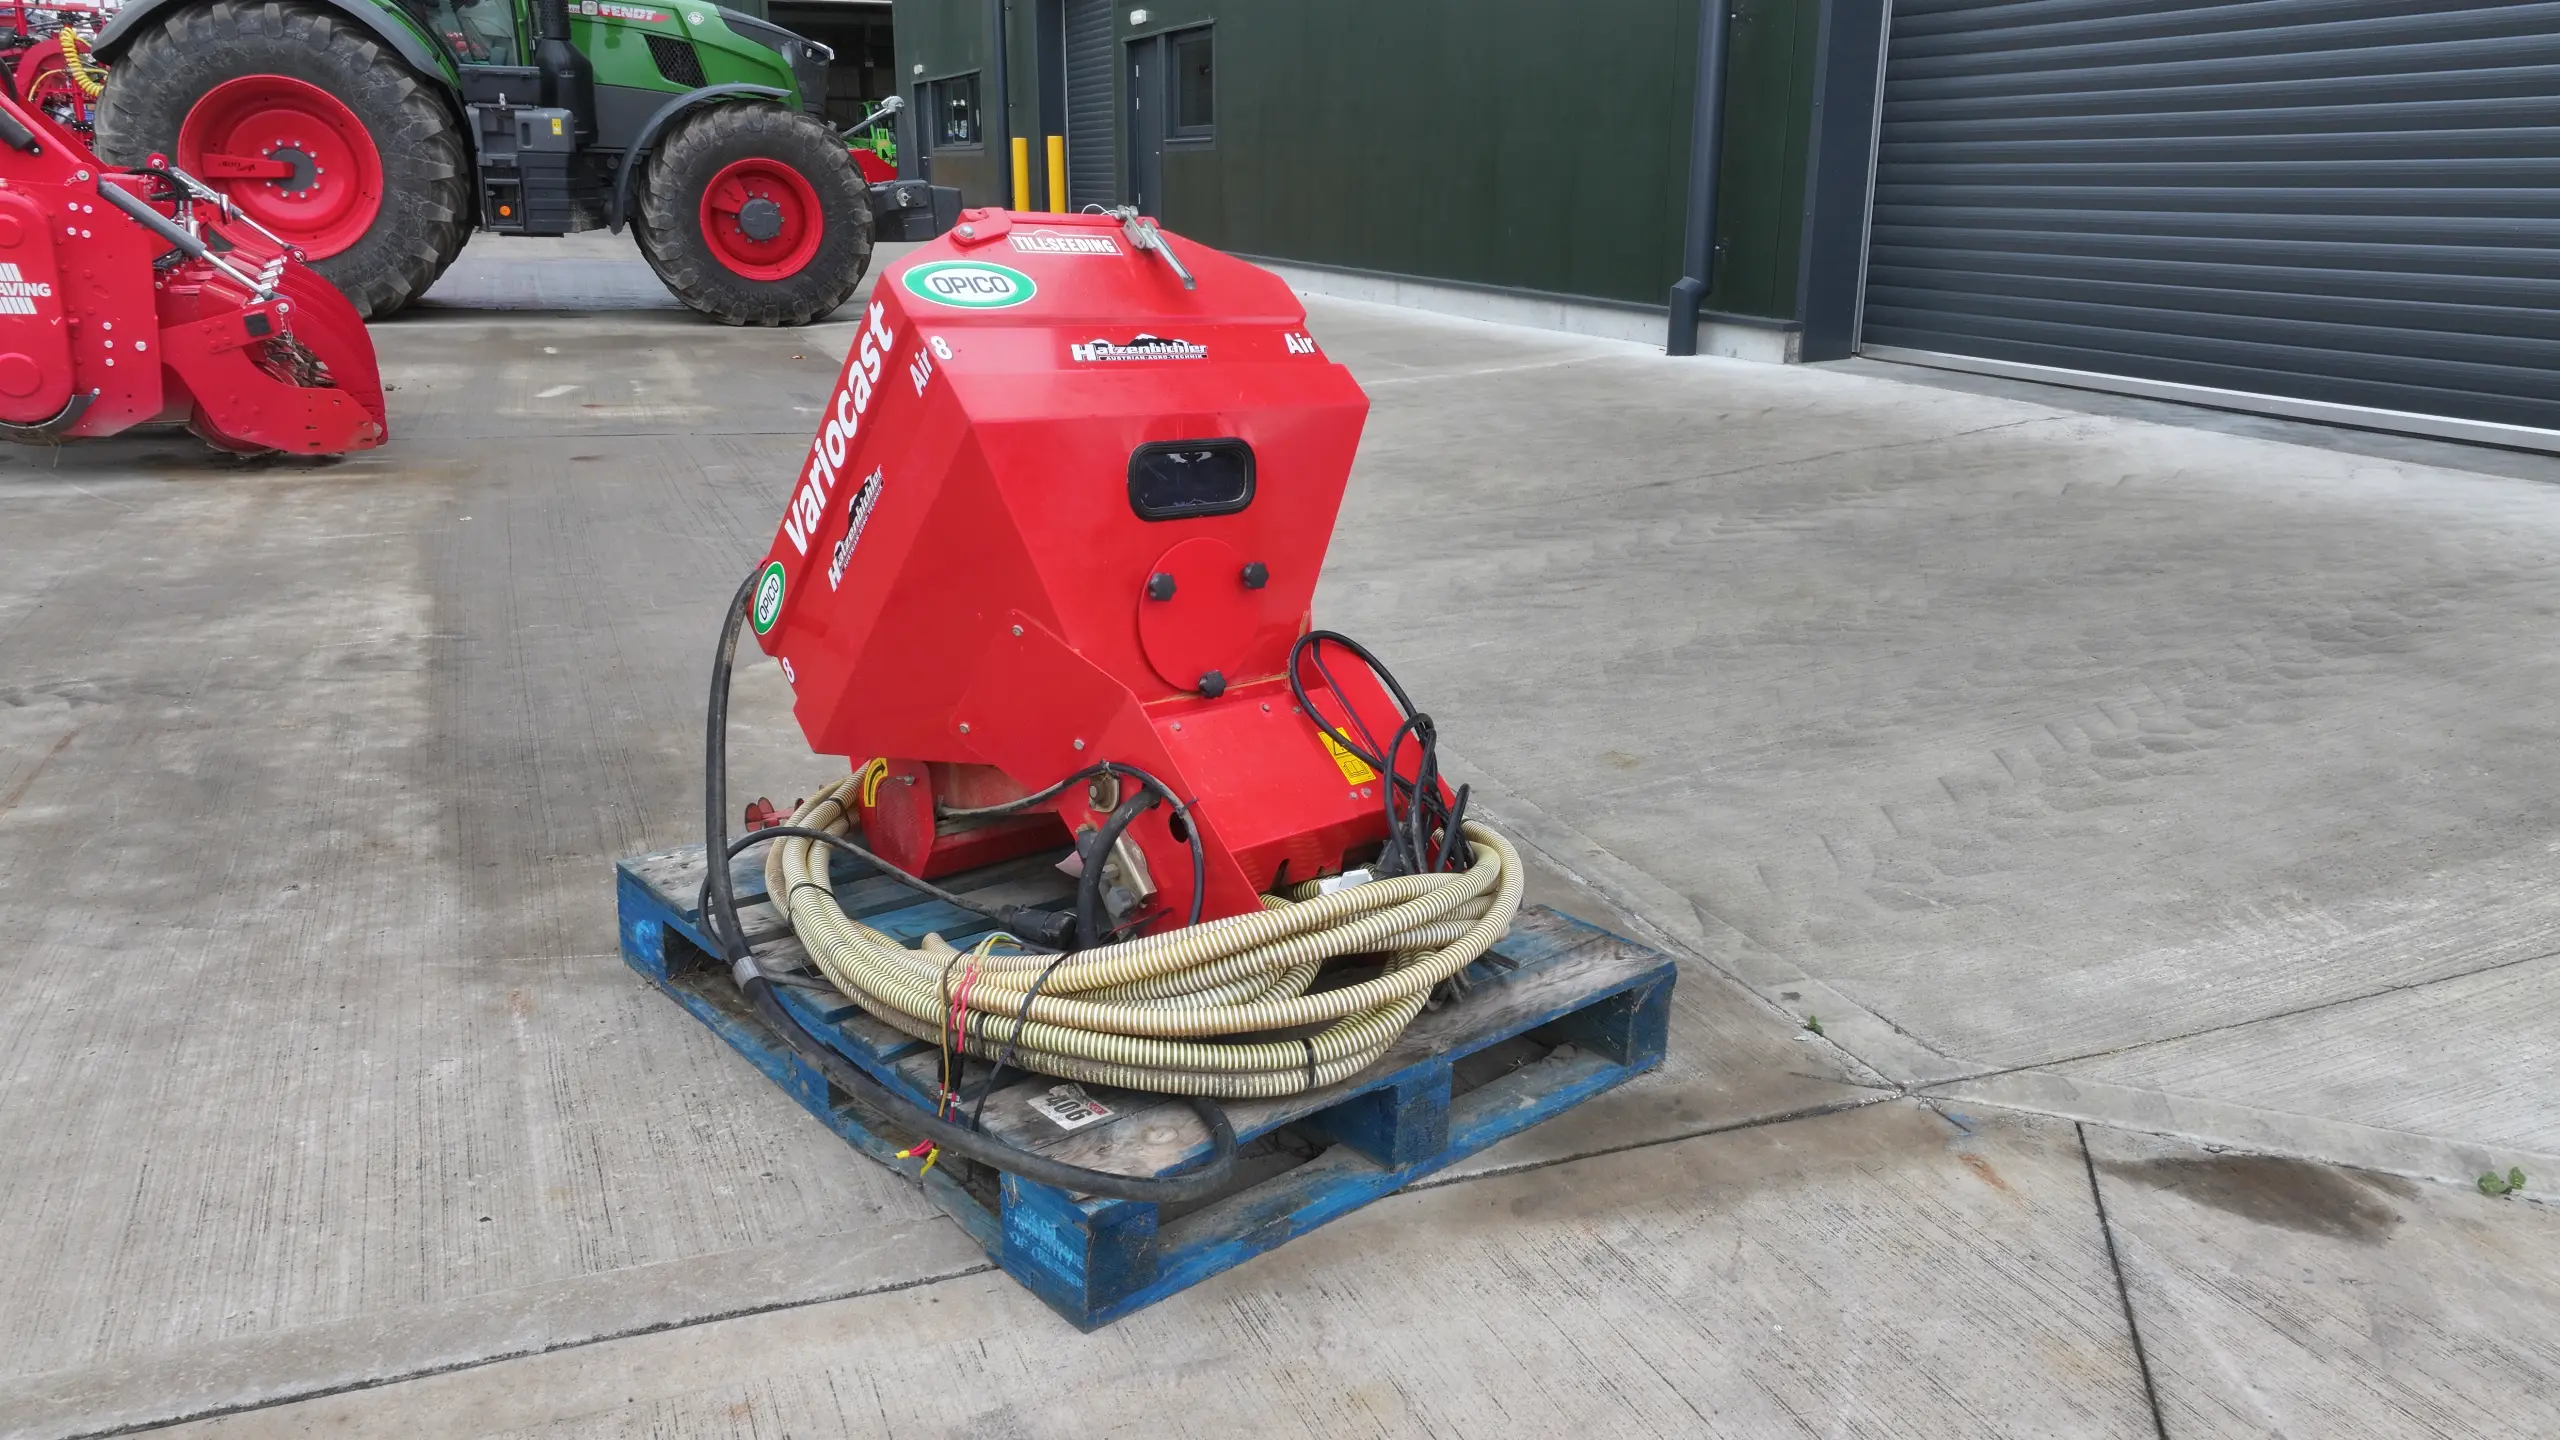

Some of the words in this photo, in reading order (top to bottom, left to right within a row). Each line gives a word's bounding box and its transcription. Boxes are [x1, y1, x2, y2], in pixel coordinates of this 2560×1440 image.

[600, 4, 656, 20] FENDT
[931, 276, 1010, 294] OPICO
[1071, 343, 1207, 361] Hatzenbichler
[1284, 332, 1316, 354] Air
[909, 346, 933, 399] Air
[930, 335, 953, 360] 8
[784, 300, 894, 557] Variocast
[828, 463, 883, 593] Hatzenbichler
[759, 577, 779, 621] OPICO
[782, 656, 795, 684] 8
